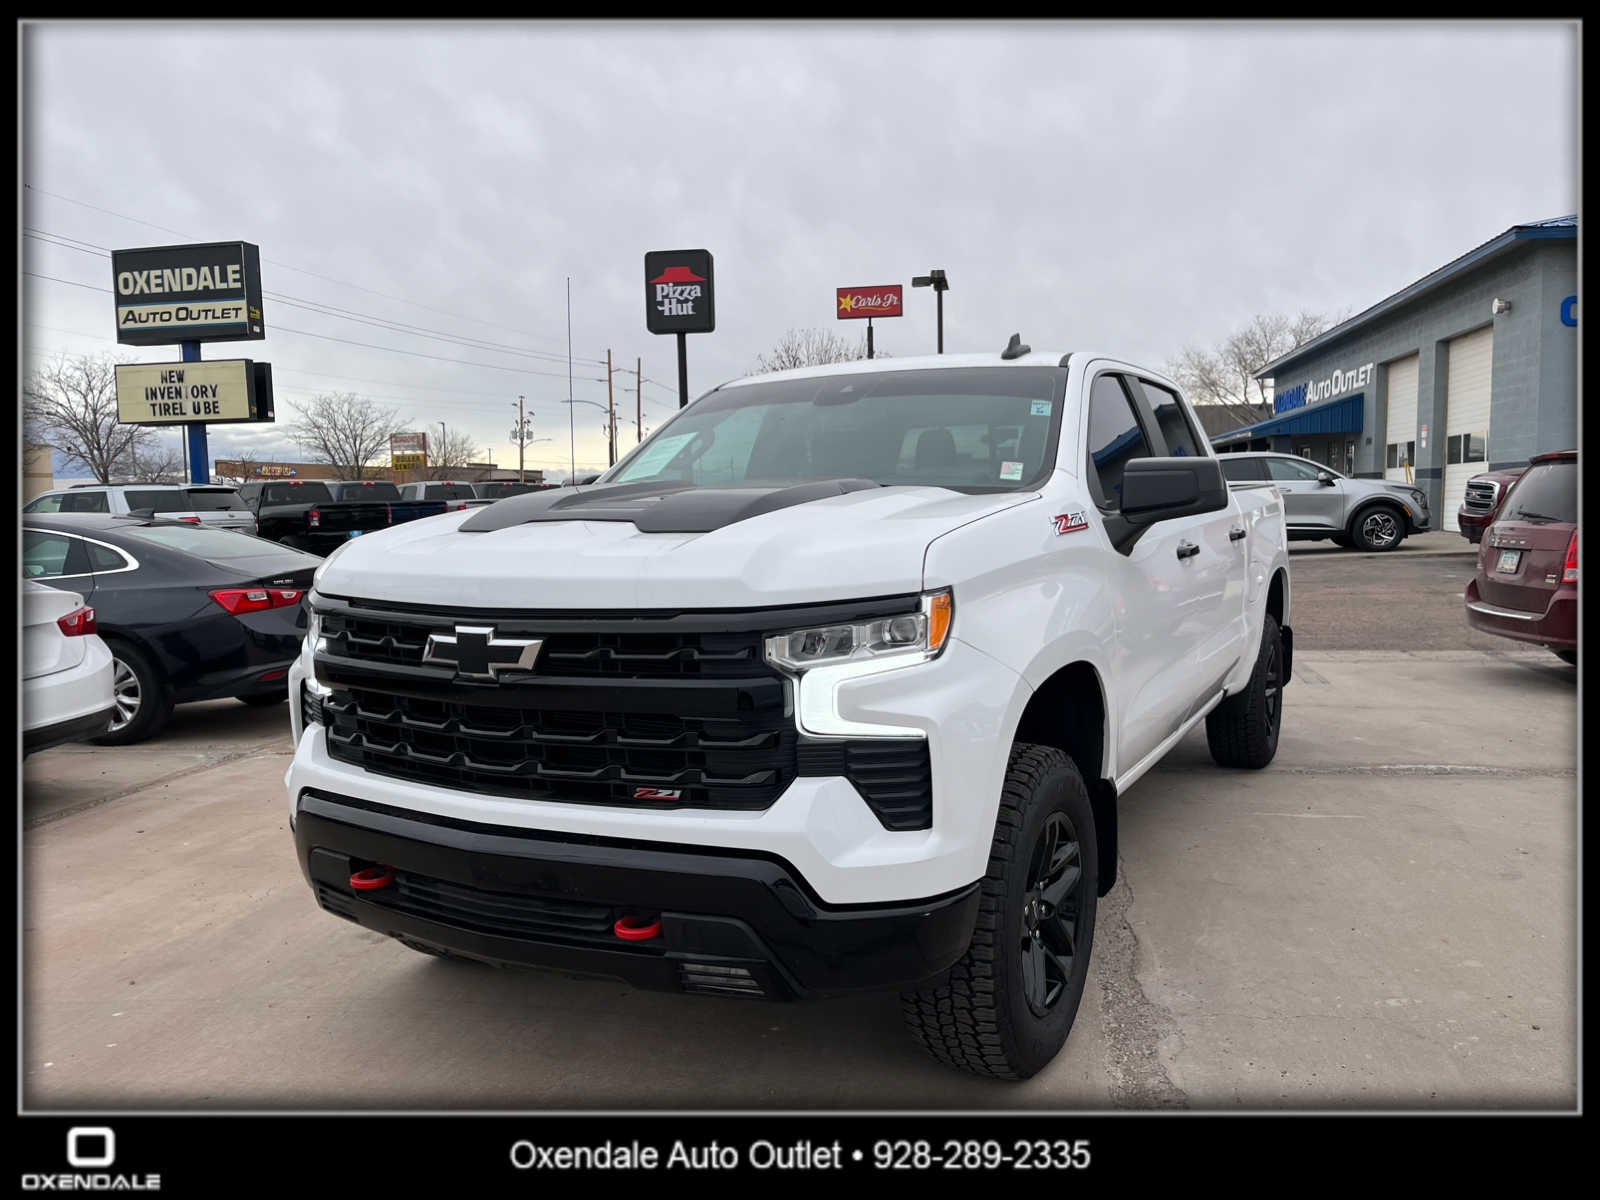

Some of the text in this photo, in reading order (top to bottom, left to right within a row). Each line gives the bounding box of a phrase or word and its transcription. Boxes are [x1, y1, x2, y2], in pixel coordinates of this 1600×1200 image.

[118, 264, 242, 296] OXENDALE
[656, 283, 701, 302] Pizza
[852, 293, 881, 309] Carl's
[122, 310, 172, 325] AUTO
[175, 307, 242, 322] OUTLET
[657, 298, 696, 316] Hut
[161, 369, 185, 384] NEW
[1306, 380, 1331, 405] AUTO
[1331, 362, 1374, 396] OUTLET
